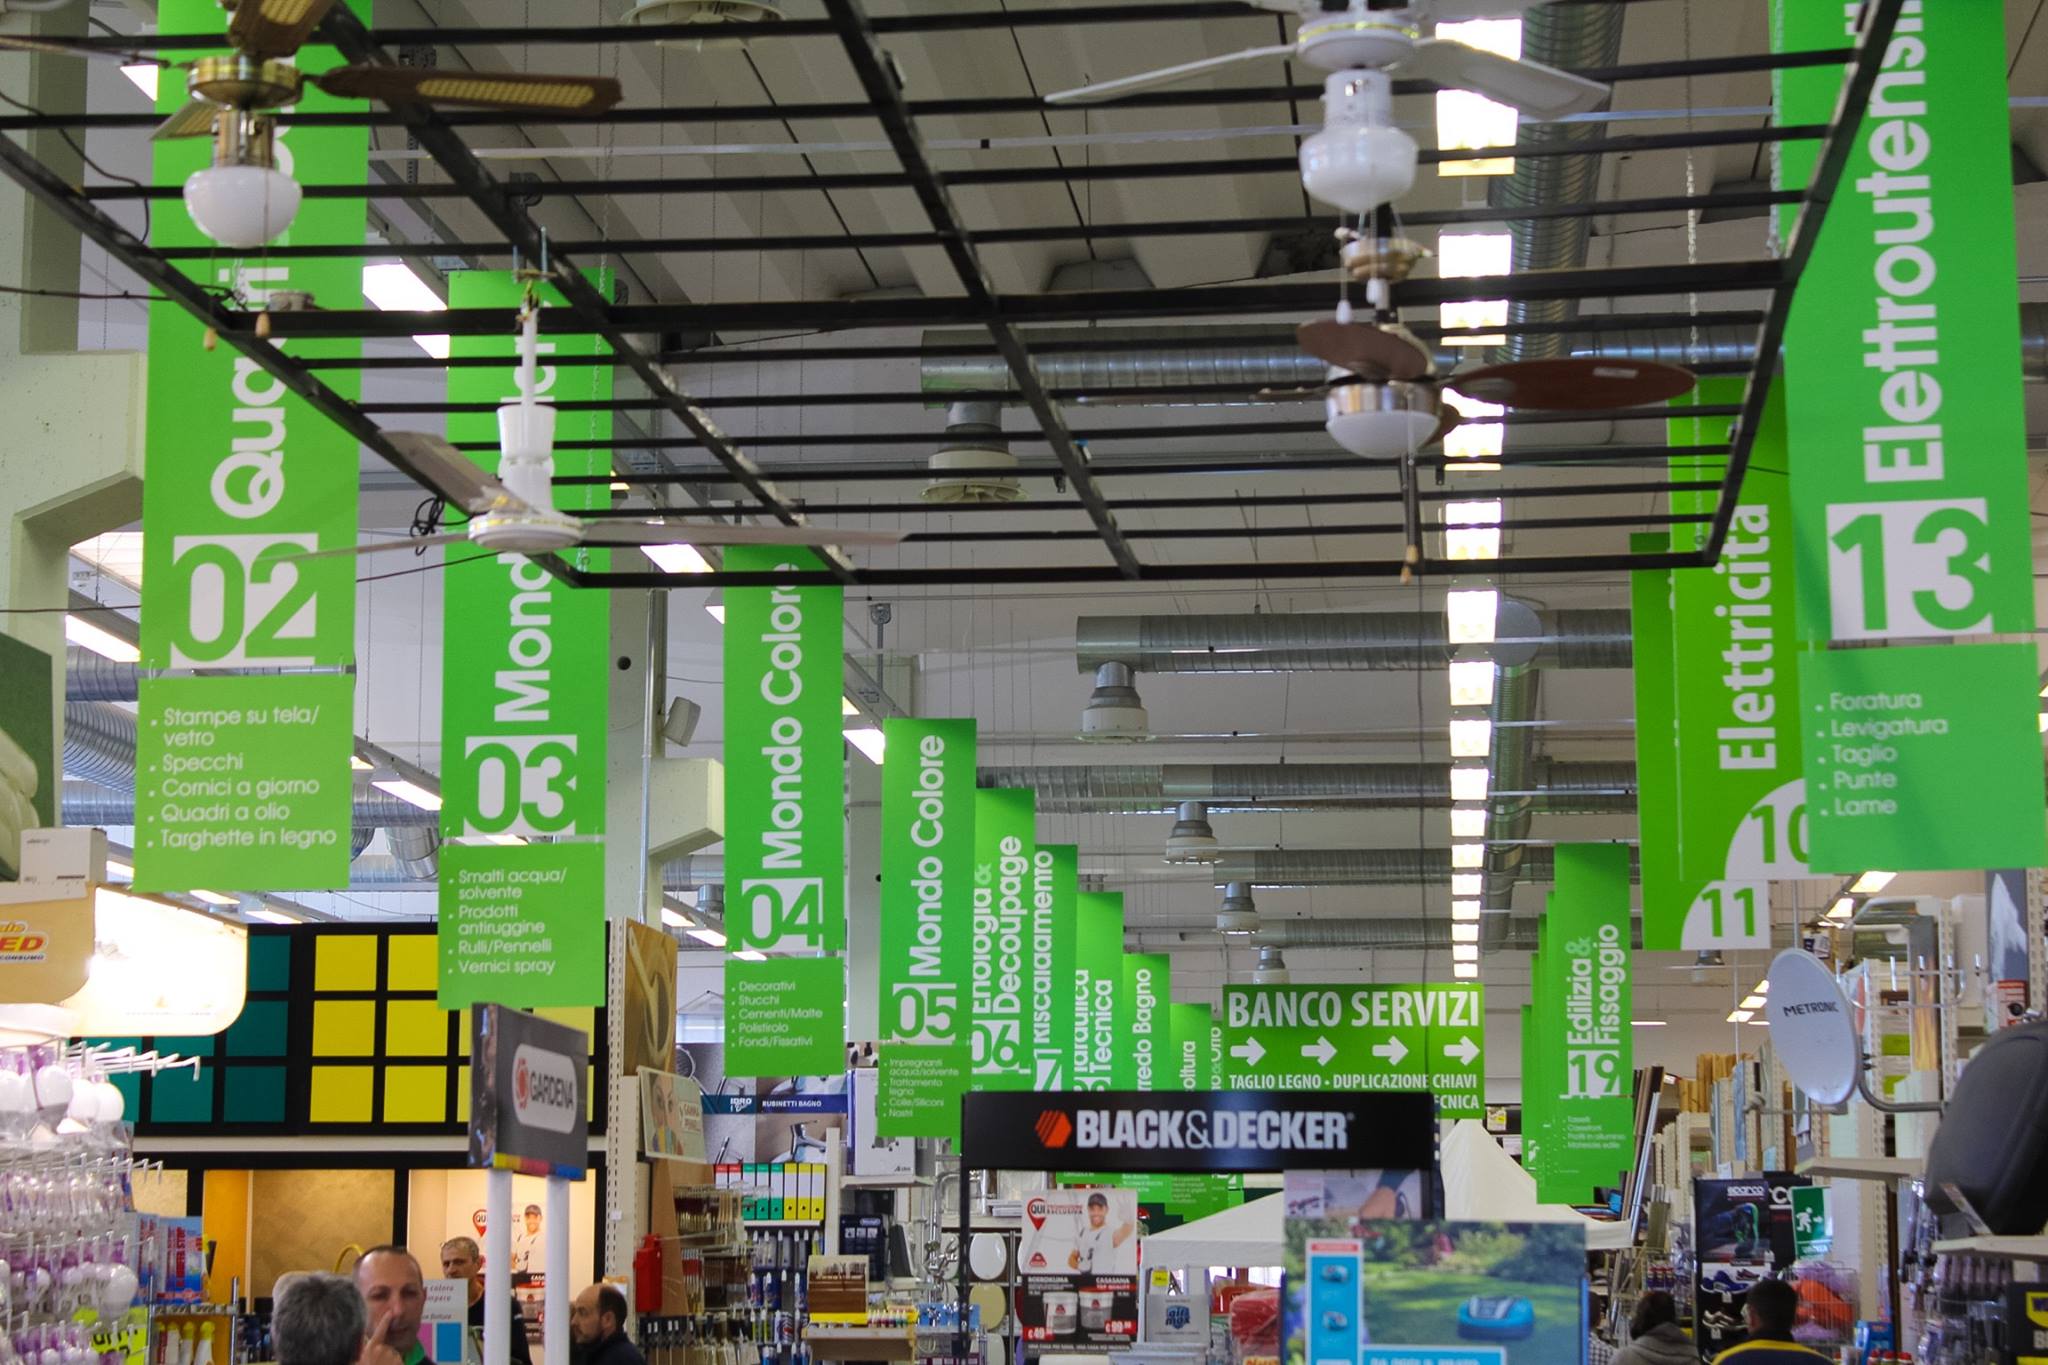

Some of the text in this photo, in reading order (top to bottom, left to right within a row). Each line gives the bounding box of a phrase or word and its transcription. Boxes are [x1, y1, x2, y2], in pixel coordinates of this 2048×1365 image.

[1828, 503, 1991, 634] 13
[170, 538, 317, 664] 02
[494, 551, 552, 722] Mond
[1830, 692, 1923, 711] Foratura
[164, 705, 320, 728] Stampe su tela/
[164, 731, 215, 746] vetro
[1831, 717, 1949, 740] Levigatura
[163, 753, 243, 774] Specchi
[1832, 744, 1898, 766] Taglio
[162, 778, 320, 799] Cornici a giorno
[465, 738, 578, 835] 03
[1834, 770, 1898, 790] Punte
[762, 717, 803, 869] Mondo
[161, 803, 290, 822] Quadri a olio
[1835, 797, 1898, 817] Lame
[160, 828, 337, 850] Targhette in legno
[909, 735, 945, 976] Mondo Colore
[459, 868, 567, 886] Smalti acqua/
[459, 886, 522, 900] solvente
[458, 905, 518, 919] Prodotti
[742, 882, 822, 950] 04
[1702, 887, 1755, 938] 11
[458, 921, 545, 937] antiruggine
[992, 835, 1028, 1014] Decoupage
[458, 939, 552, 955] Rulli/Pennelli
[458, 960, 556, 976] Vernici spray
[739, 981, 796, 991] Decorativi
[1594, 924, 1627, 1044] Fissaggio
[739, 995, 780, 1005] Stucchi
[1131, 968, 1157, 1034] Bagno
[1228, 991, 1479, 1028] BANCO SERVIZI
[1567, 959, 1593, 1044] Edilizia
[739, 1009, 823, 1020] Cementi/Malte
[892, 984, 957, 1040] 05
[739, 1023, 790, 1033] Polistirolo
[1089, 979, 1113, 1074] Tecnica
[738, 1036, 814, 1047] Fondi/Fissativi
[971, 1022, 1020, 1070] 06
[1229, 1073, 1477, 1089] TAGLIO LEGNO DUPLICAZIONE CHIAVI
[1568, 1052, 1620, 1095] 19
[529, 1071, 575, 1110] GARDENA
[762, 1100, 822, 1109] RUBINETTI BAGNO
